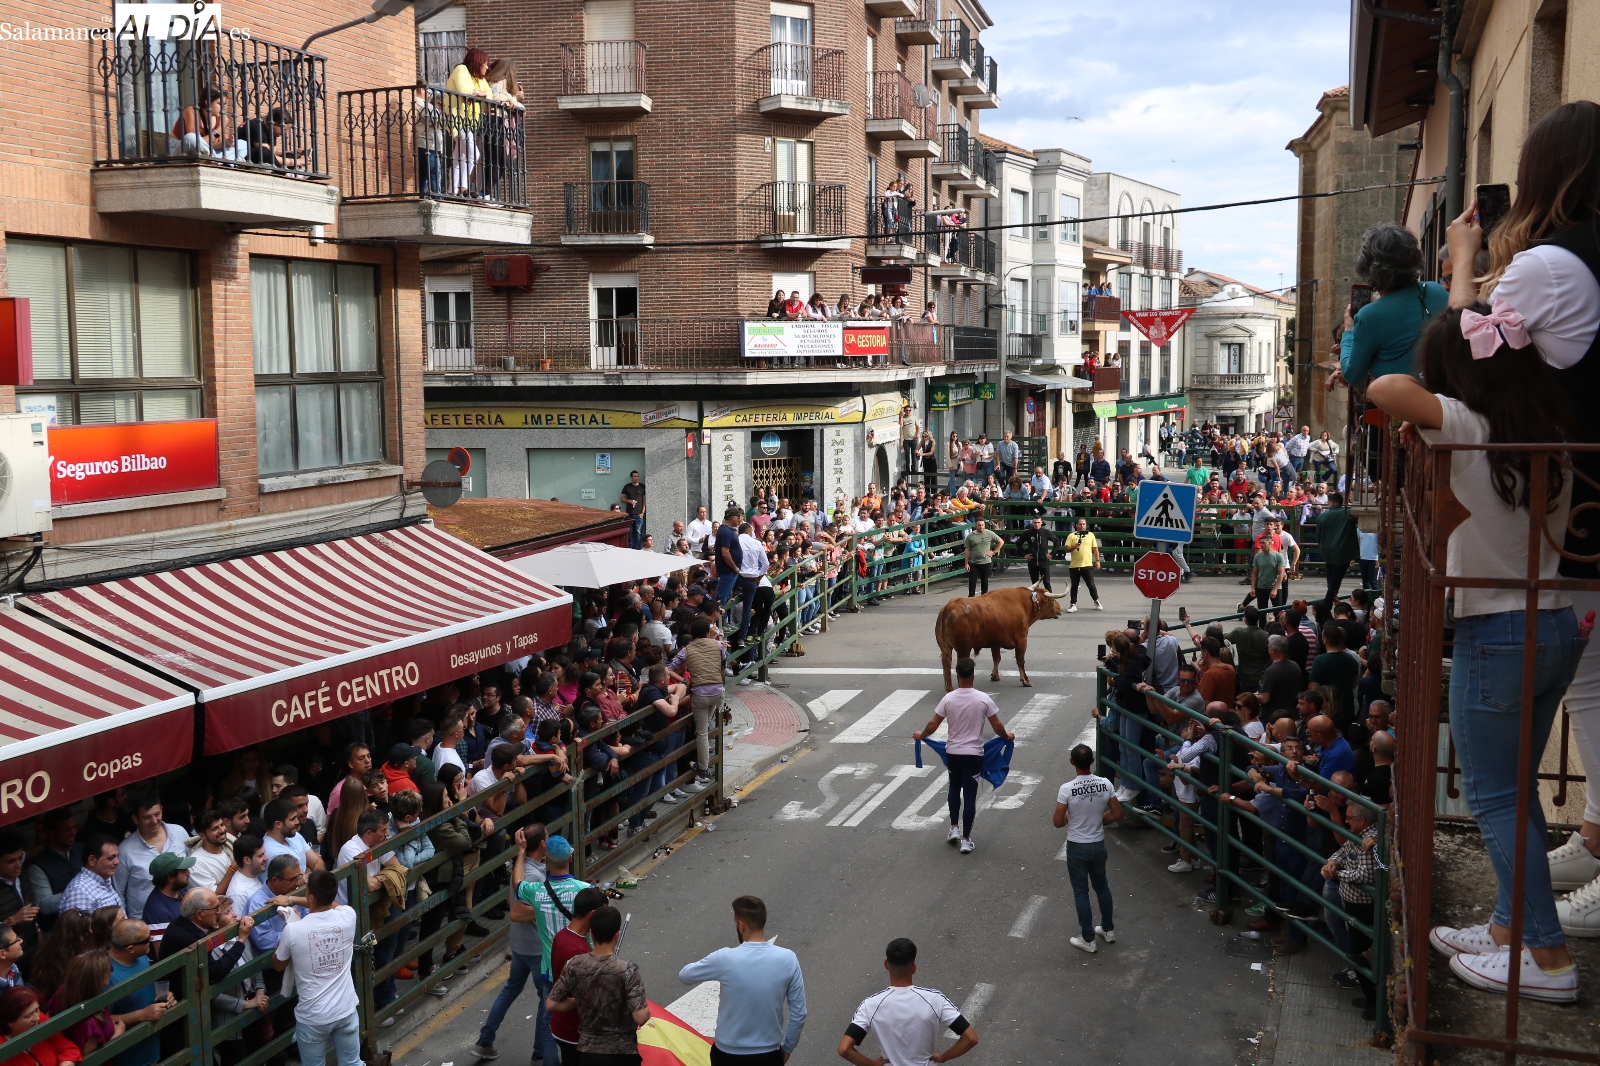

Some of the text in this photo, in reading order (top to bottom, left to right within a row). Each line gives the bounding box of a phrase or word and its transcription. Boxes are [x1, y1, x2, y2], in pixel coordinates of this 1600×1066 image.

[857, 334, 887, 348] GESTORIA
[979, 391, 994, 400] 24h
[522, 412, 612, 427] IMPERIAL
[734, 411, 788, 423] CAFETERÍA
[56, 454, 167, 481] Seguros Bilbao
[1137, 568, 1178, 583] STOP
[450, 632, 539, 669] Desayunos y Tapas
[271, 661, 420, 727] CAFÉ CENTRO
[83, 752, 143, 782] Copas
[0, 770, 51, 814] RO
[773, 762, 1045, 832] STOP
[1071, 783, 1108, 797] BOXEUR
